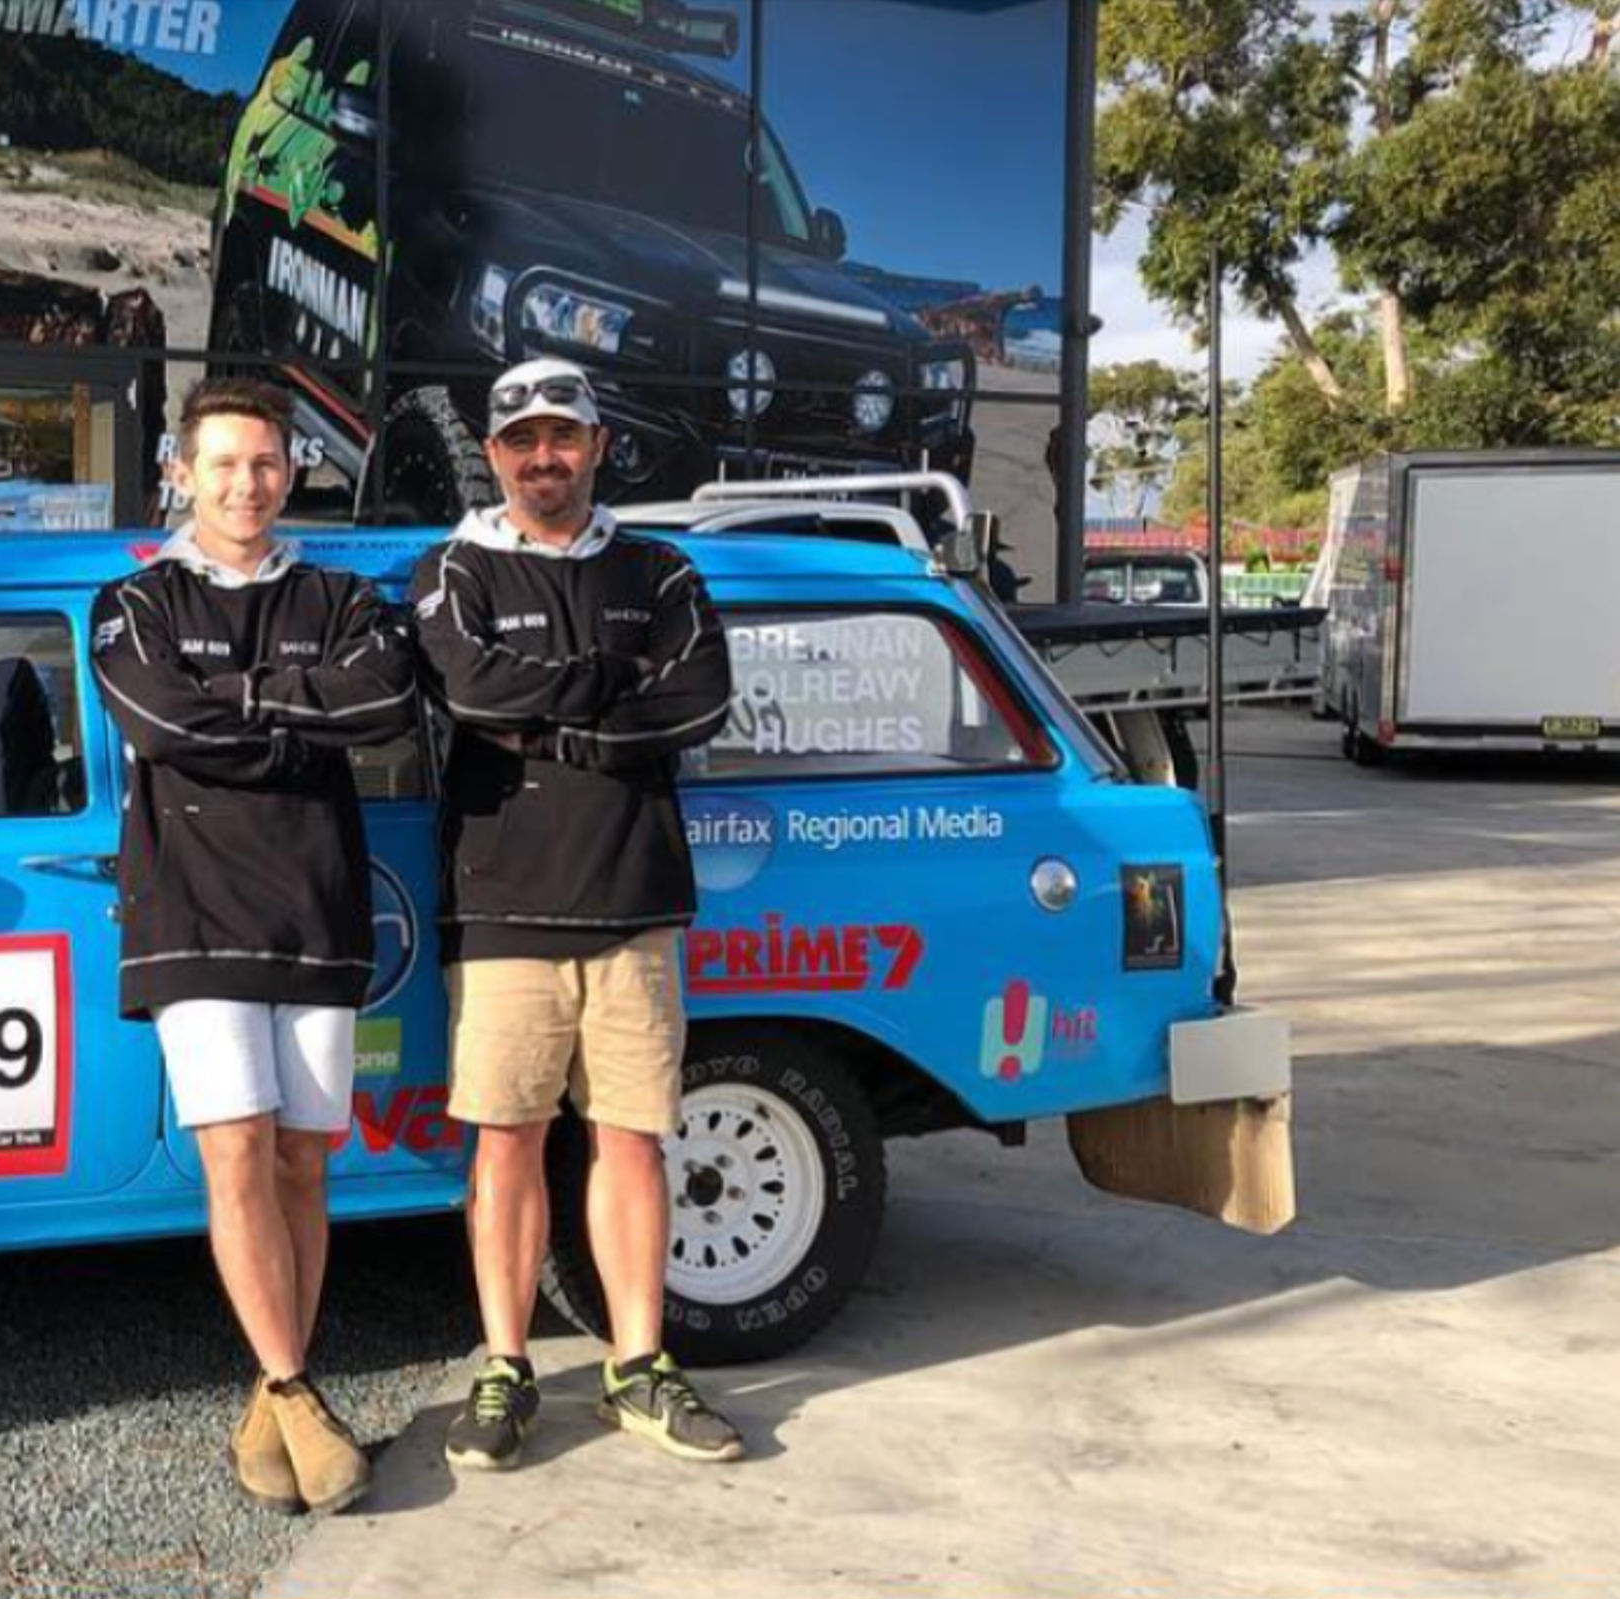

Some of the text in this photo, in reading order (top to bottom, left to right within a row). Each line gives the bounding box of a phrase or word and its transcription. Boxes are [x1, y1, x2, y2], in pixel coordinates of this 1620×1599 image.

[267, 236, 368, 348] IRONMAN
[731, 626, 922, 661] BRENNAN
[754, 715, 924, 754] HUGHES
[686, 804, 1004, 850] airfax Regional Media
